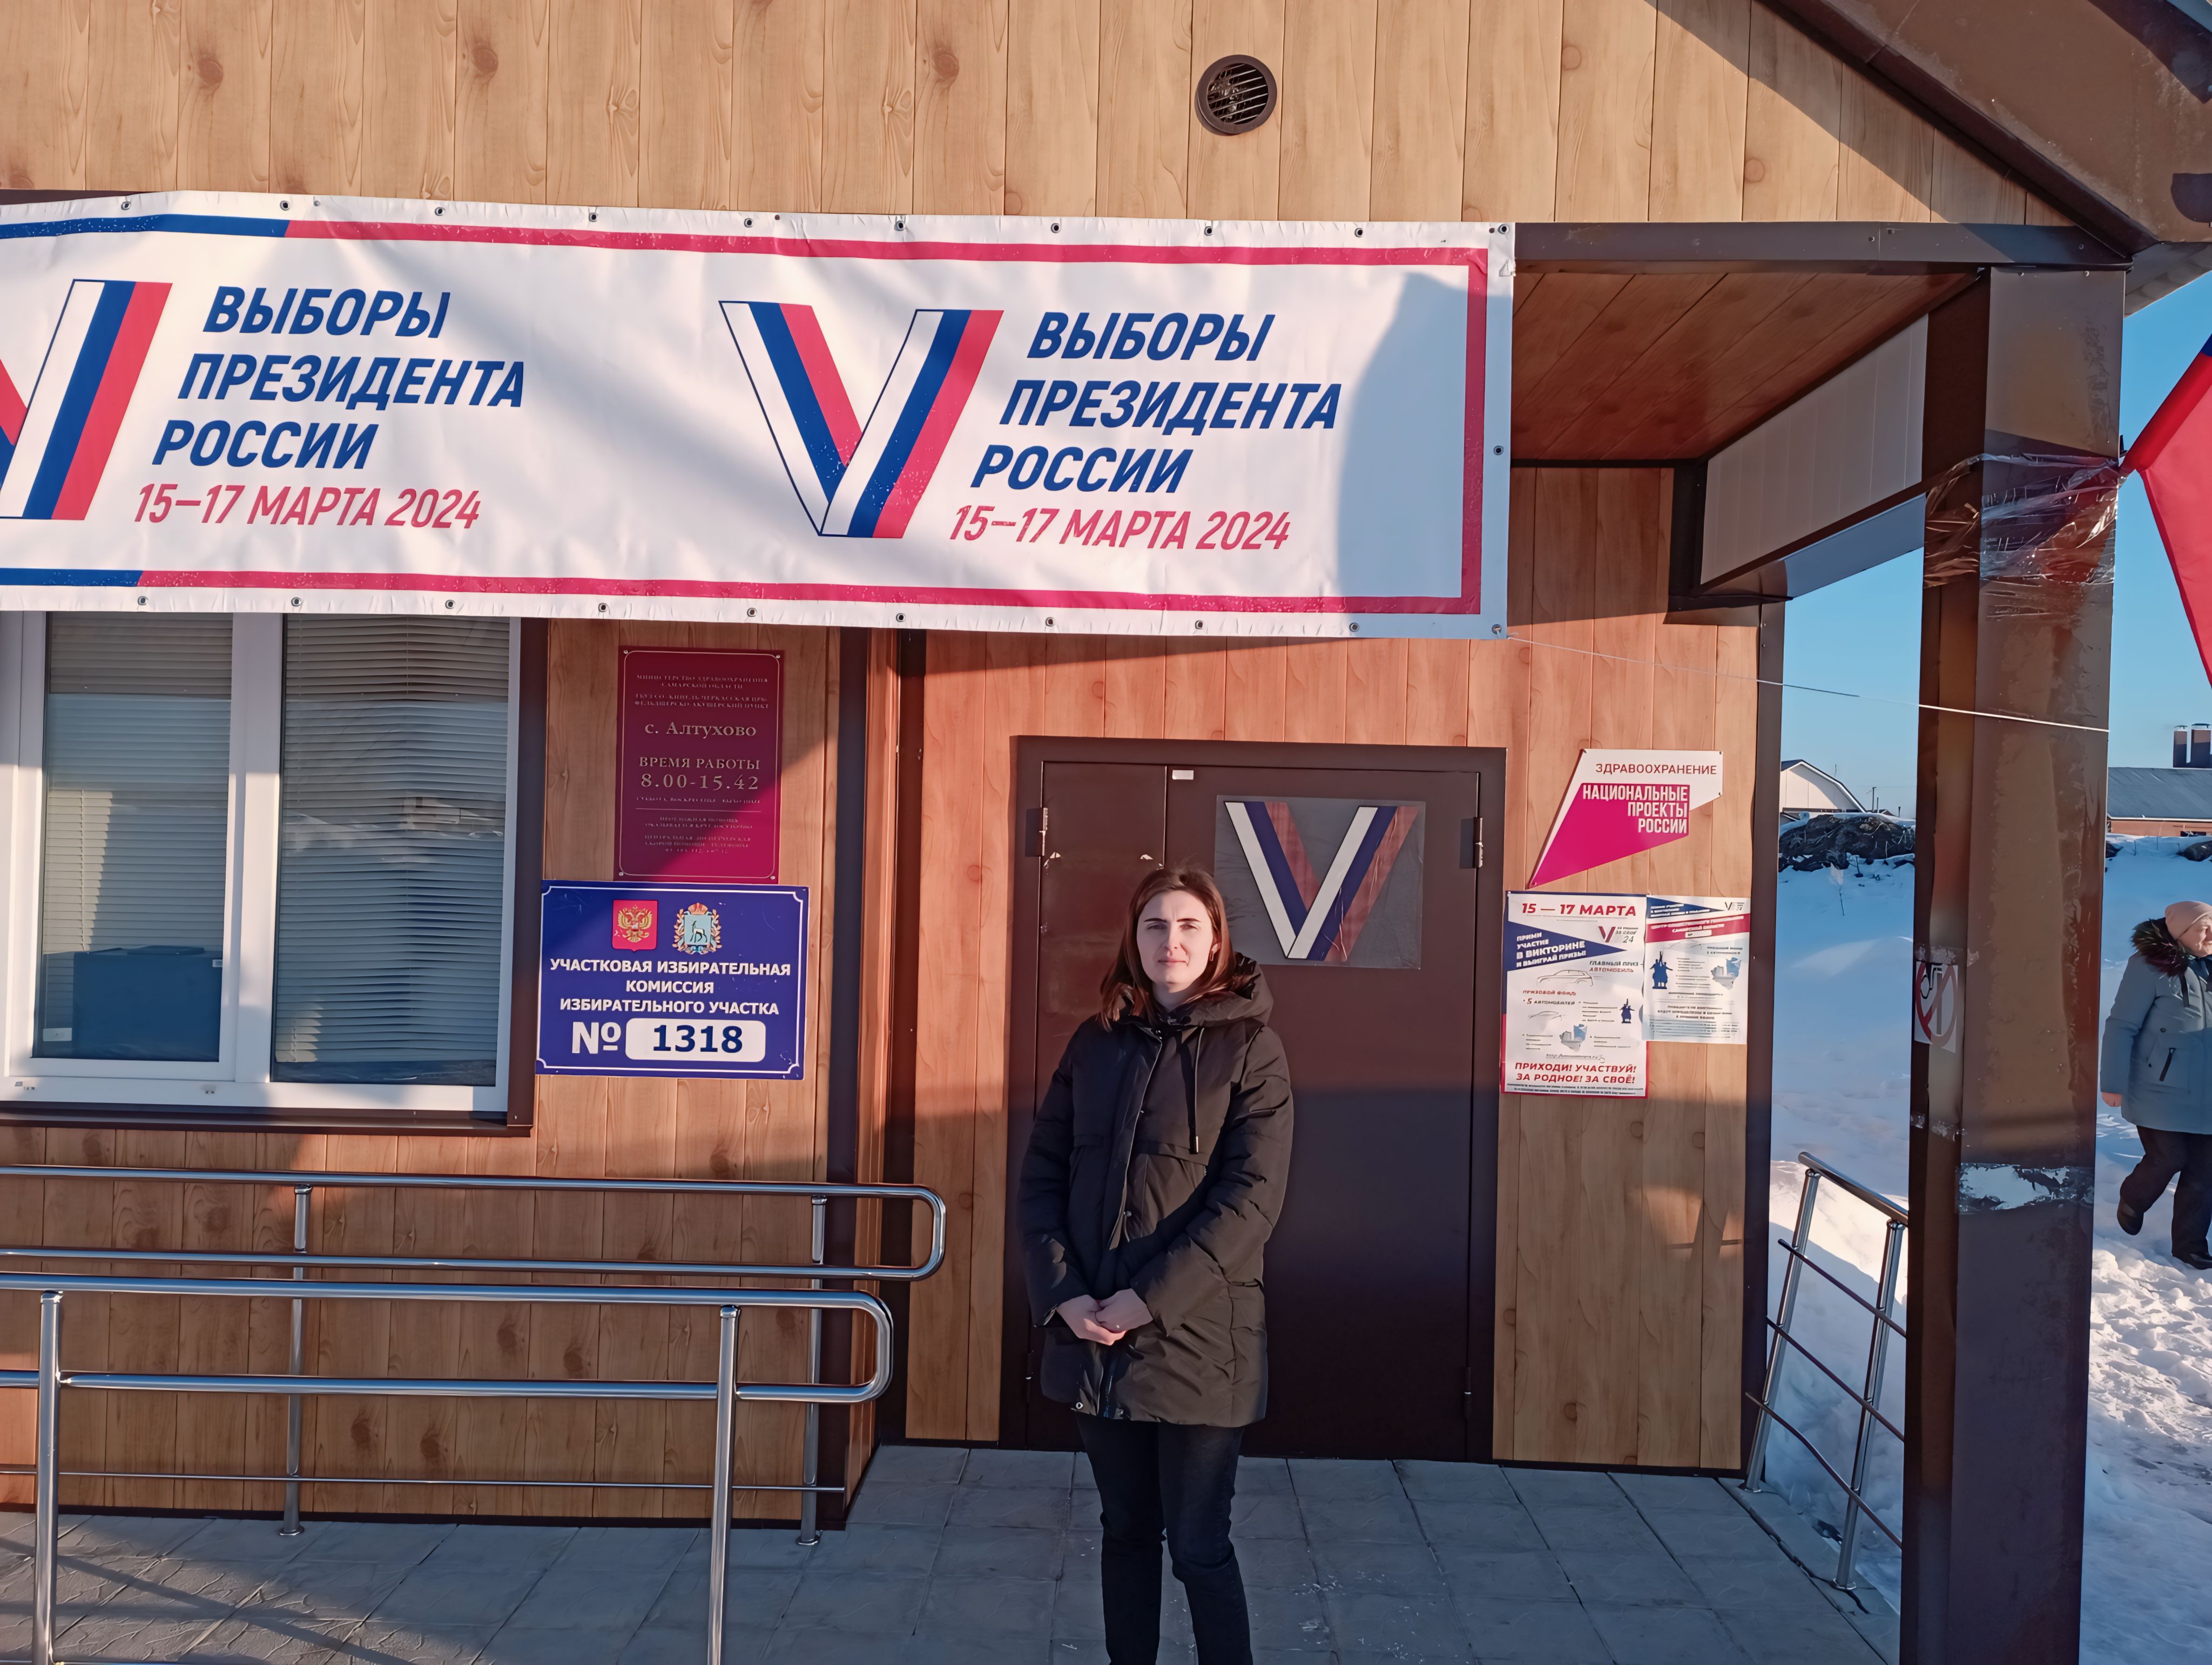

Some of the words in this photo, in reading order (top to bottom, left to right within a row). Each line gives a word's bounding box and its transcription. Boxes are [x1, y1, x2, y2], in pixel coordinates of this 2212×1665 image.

[204, 286, 450, 339] ВЫБОРЫ
[1027, 312, 1276, 361] ВЫБОРЫ
[178, 353, 524, 411] ПРЕЗИДЕНТА
[1000, 380, 1341, 436] ПРЕЗИДЕНТА
[152, 419, 379, 469] РОССИИ
[970, 444, 1193, 493] РОССИИ
[247, 485, 383, 527] МАРТА
[385, 488, 481, 530] 2024
[1060, 509, 1191, 550] МАРТА
[1195, 510, 1291, 551] 2024
[645, 724, 659, 734] с.
[666, 722, 757, 739] Алтухово
[639, 757, 690, 768] ВРЕМЯ
[697, 759, 760, 770] РАБОТЫ
[1595, 763, 1717, 775] ЗДРАВООХРАНЕНИЕ
[1583, 785, 1688, 801] НАЦИОНАЛЬНЫЕ
[1628, 802, 1688, 817] ПРОЕКТЫ
[1638, 818, 1687, 834] РОССИИ
[1522, 903, 1537, 914] 15
[1560, 904, 1576, 915] 17
[1579, 904, 1636, 917] МАРТА
[1526, 940, 1586, 958] ВИКТОРИНЕ
[550, 958, 652, 972] УЧАСТКОВАЯ
[657, 960, 791, 976] ИЗБИРАТЕЛЬНАЯ
[626, 980, 714, 994] КОМИССИЯ
[560, 998, 705, 1013] ИЗБИРАТЕЛЬНОГО
[709, 1001, 780, 1015] УЧАСТКА
[572, 1021, 622, 1054] №
[653, 1024, 743, 1053] 1318
[1515, 1062, 1573, 1073] ПРИХОДИ!
[1575, 1064, 1637, 1073] УЧАСТВУЙ!
[1534, 1074, 1583, 1083] РОДНОЕ!
[1602, 1074, 1635, 1084] СВОЁ!
